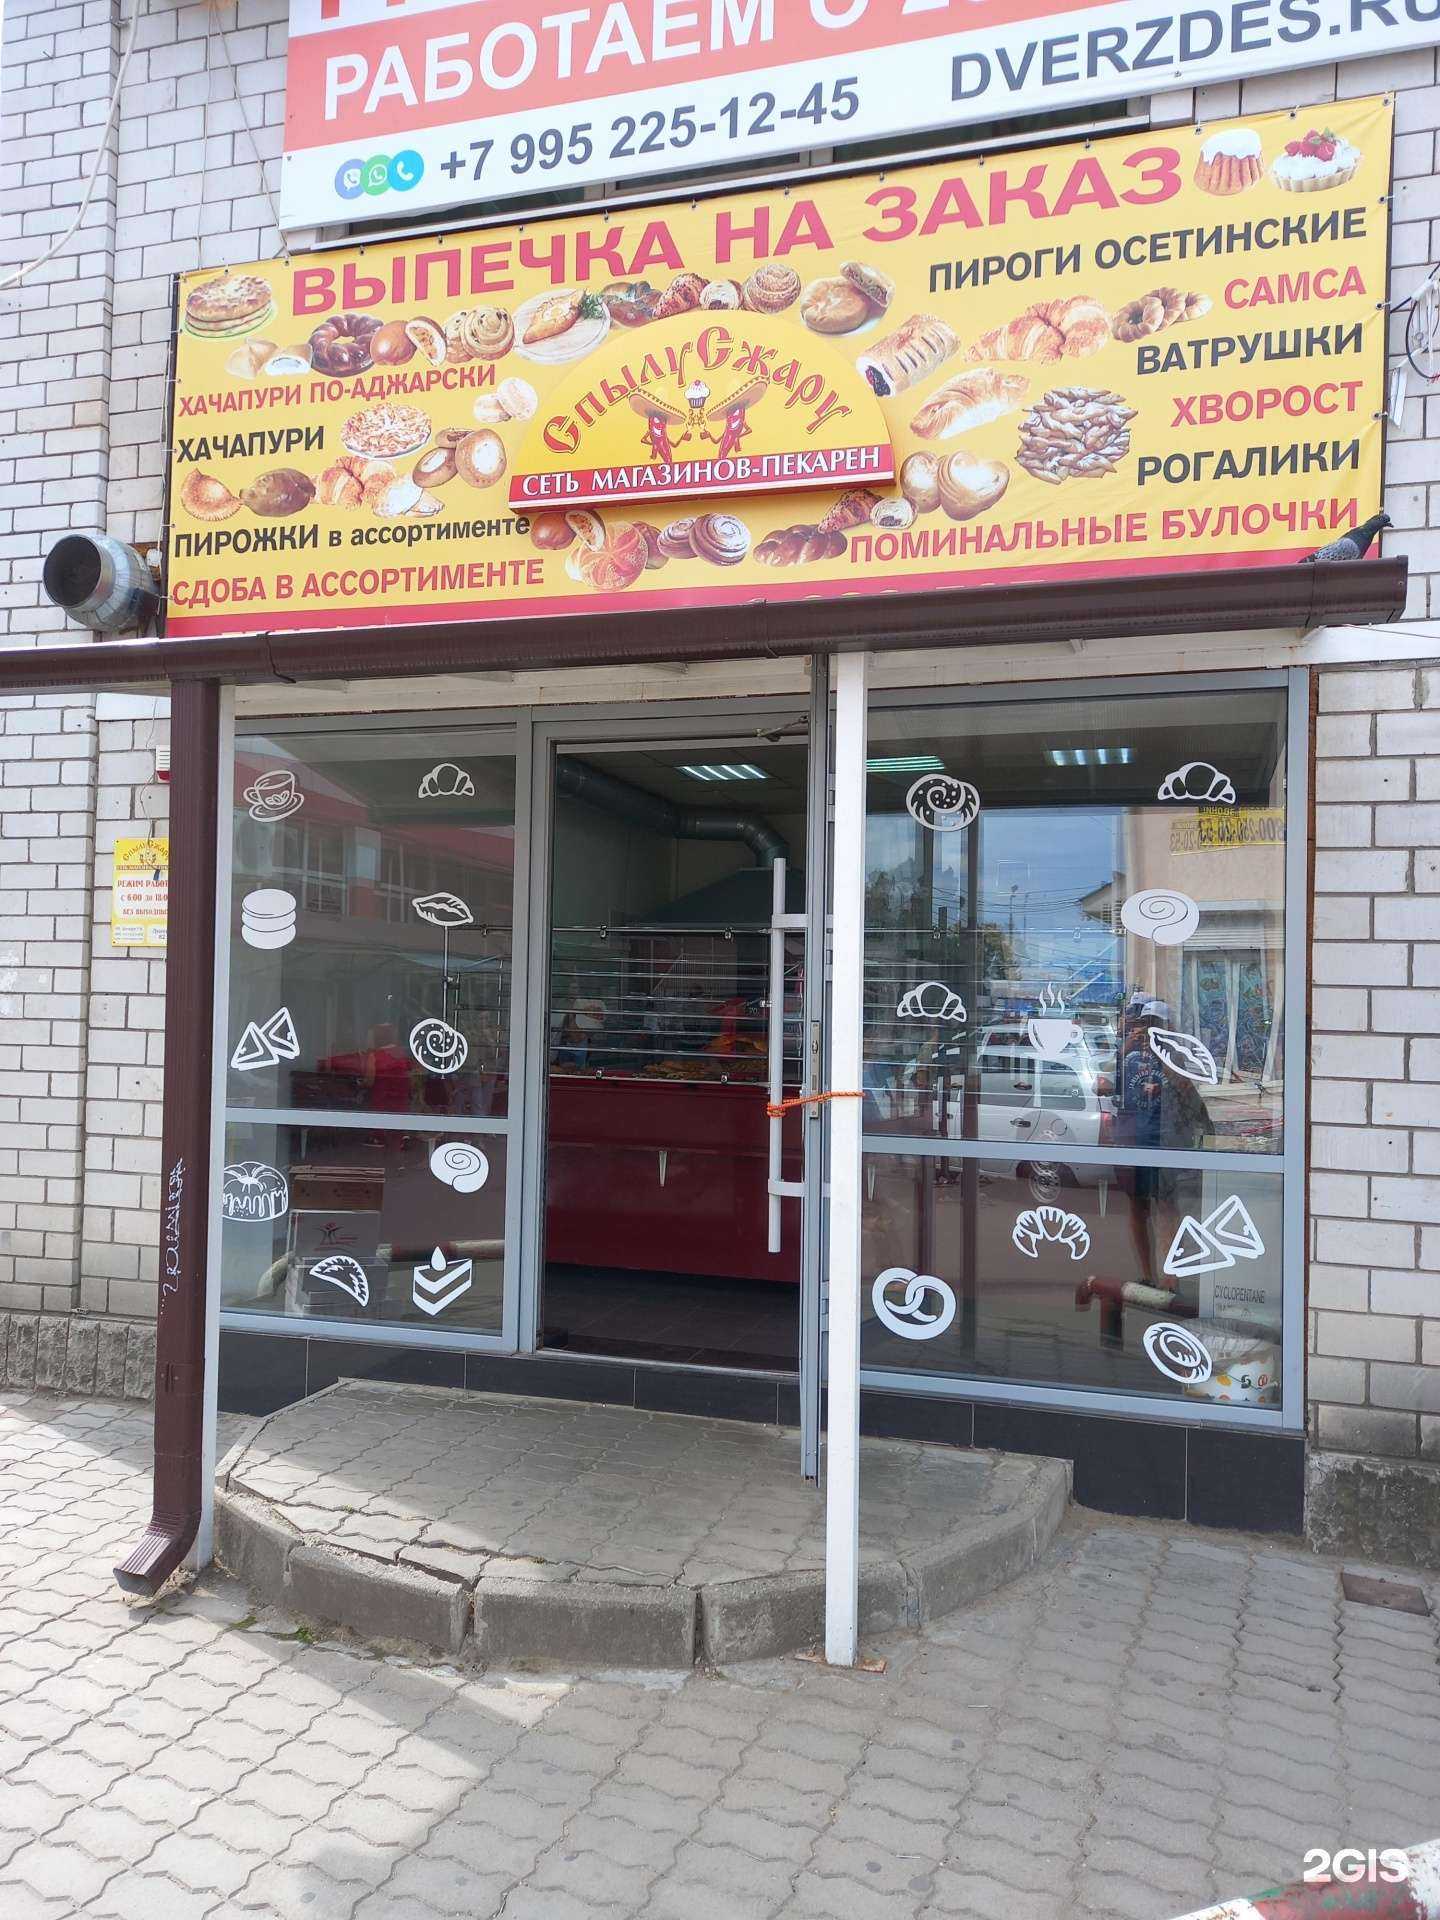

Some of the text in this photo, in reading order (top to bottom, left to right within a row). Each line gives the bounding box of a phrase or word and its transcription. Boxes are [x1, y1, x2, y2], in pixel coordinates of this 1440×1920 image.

[323, 0, 775, 122] РАБОТАЕМ
[439, 76, 860, 183] +7 995 225-12-45
[292, 147, 1183, 316] ВЫПЕЧКА НА ЗАКАЗ
[929, 206, 1367, 293] ПИРОГИ ОСЕТИНСКИЕ
[1224, 265, 1367, 310] САМСА
[1136, 322, 1364, 376] ВАТРУШКИ
[178, 364, 496, 418] ХАЧАПУРИ ПО-АДЖАРСКИ
[1170, 380, 1364, 428] ХВОРОСТ
[176, 425, 325, 463] ХАЧАПУРИ
[1137, 438, 1361, 487] РОГАЛИКИ
[521, 446, 881, 496] СЕТЬ МАГАЗИНОВ-ПЕКАРЕН
[174, 515, 531, 558] ПИРОЖКИ в ассортименте
[850, 497, 1359, 563] ПОМИНАЛЬНЫЕ БУЛОЧКИ
[172, 558, 545, 609] СДОБА В АССОРТИМЕНТЕ
